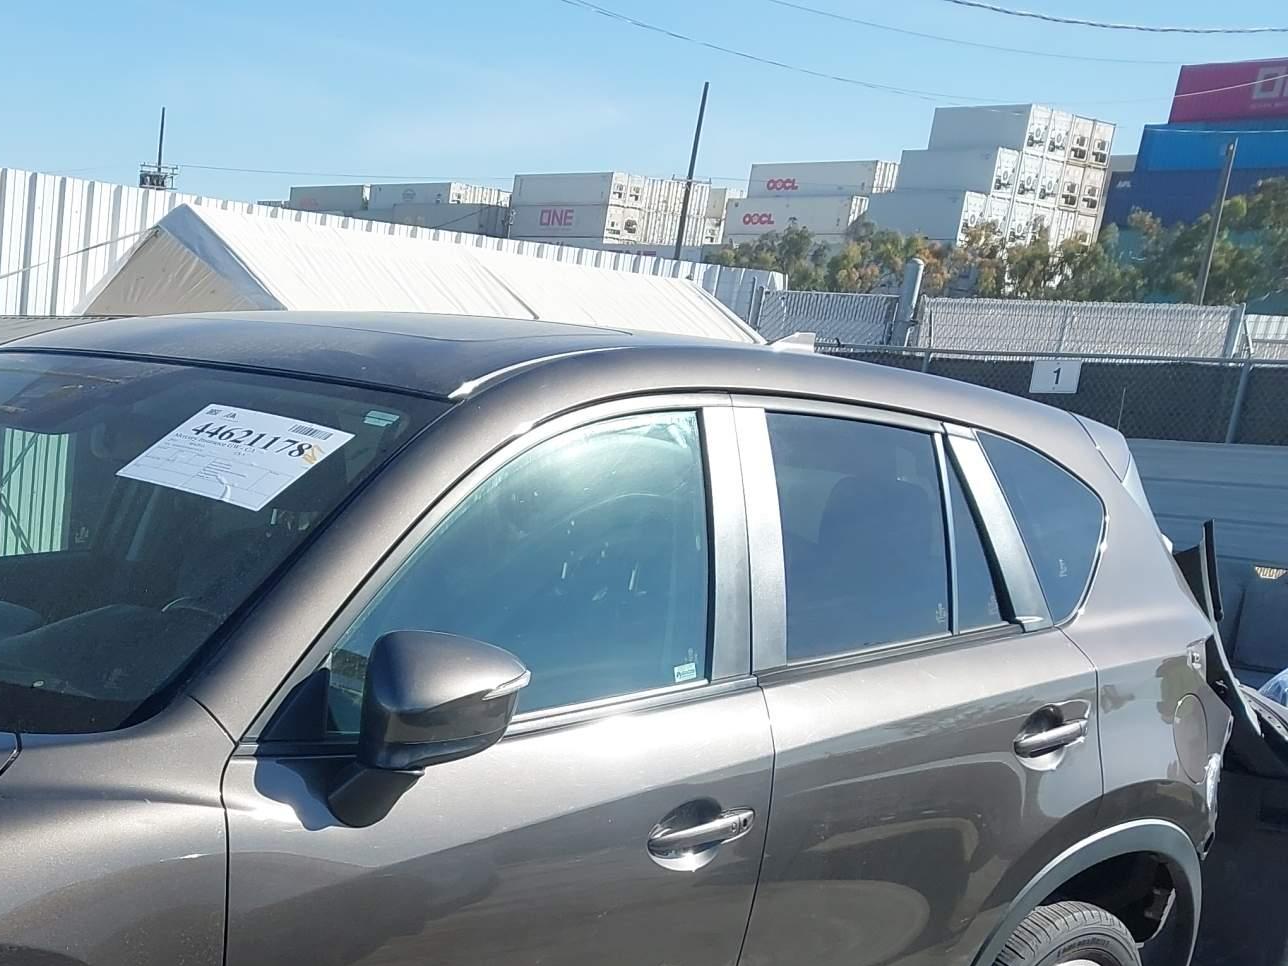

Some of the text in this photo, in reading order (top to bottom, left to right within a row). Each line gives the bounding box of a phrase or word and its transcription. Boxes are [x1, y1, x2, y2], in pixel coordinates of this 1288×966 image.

[767, 178, 799, 191] OOCL
[539, 208, 574, 226] ONE
[743, 213, 775, 225] OOCL
[1053, 367, 1062, 385] 1
[192, 422, 313, 457] 44621178
